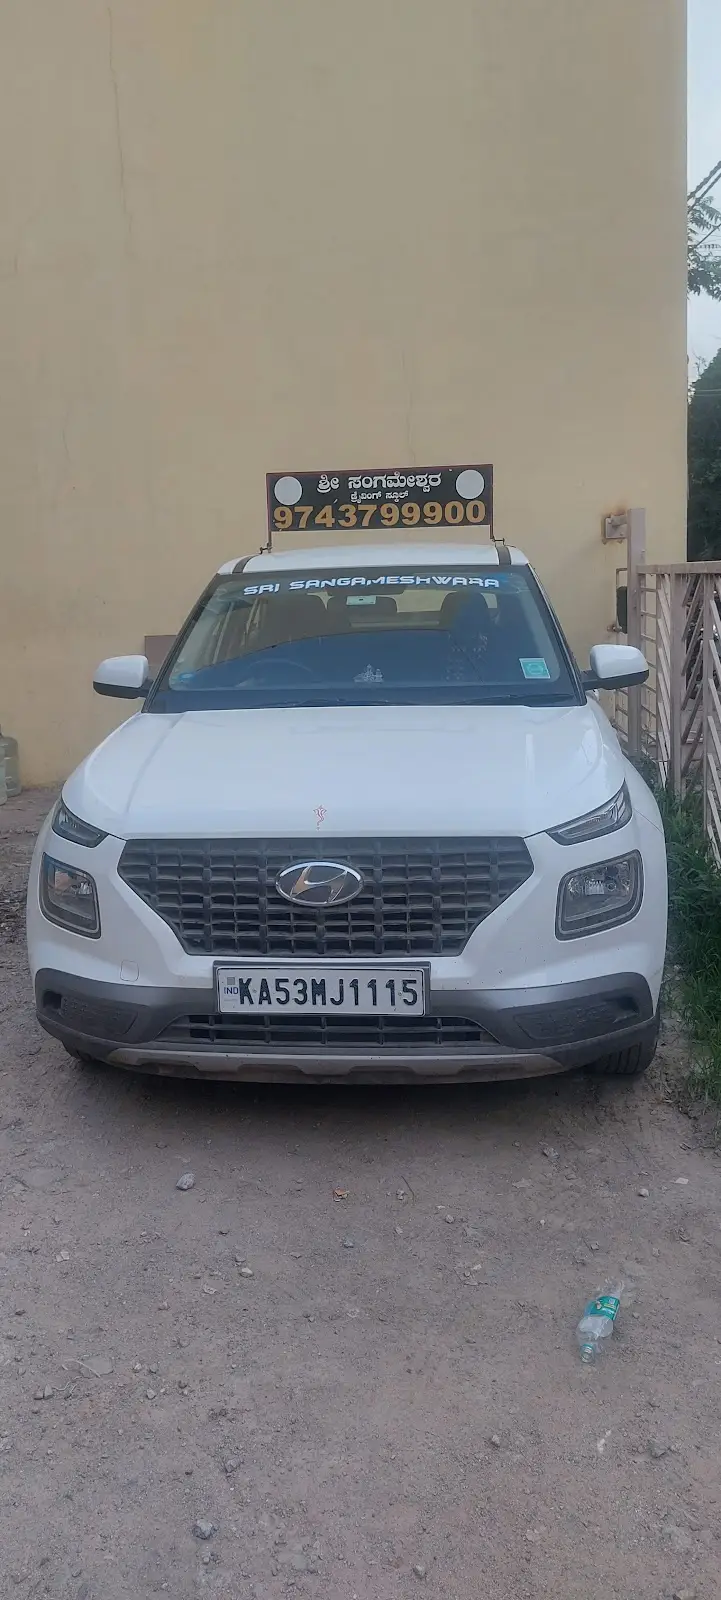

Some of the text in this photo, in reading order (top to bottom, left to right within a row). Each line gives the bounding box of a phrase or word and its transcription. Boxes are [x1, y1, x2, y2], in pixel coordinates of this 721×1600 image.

[316, 471, 442, 493] ಶ್ರೀ ಸಂಗಮೇಶ್ವರ
[273, 500, 486, 530] 9743799900
[243, 576, 500, 596] SRI SANGAMESHWARA
[223, 986, 239, 995] IND
[238, 978, 419, 1006] KA53MJ1115
